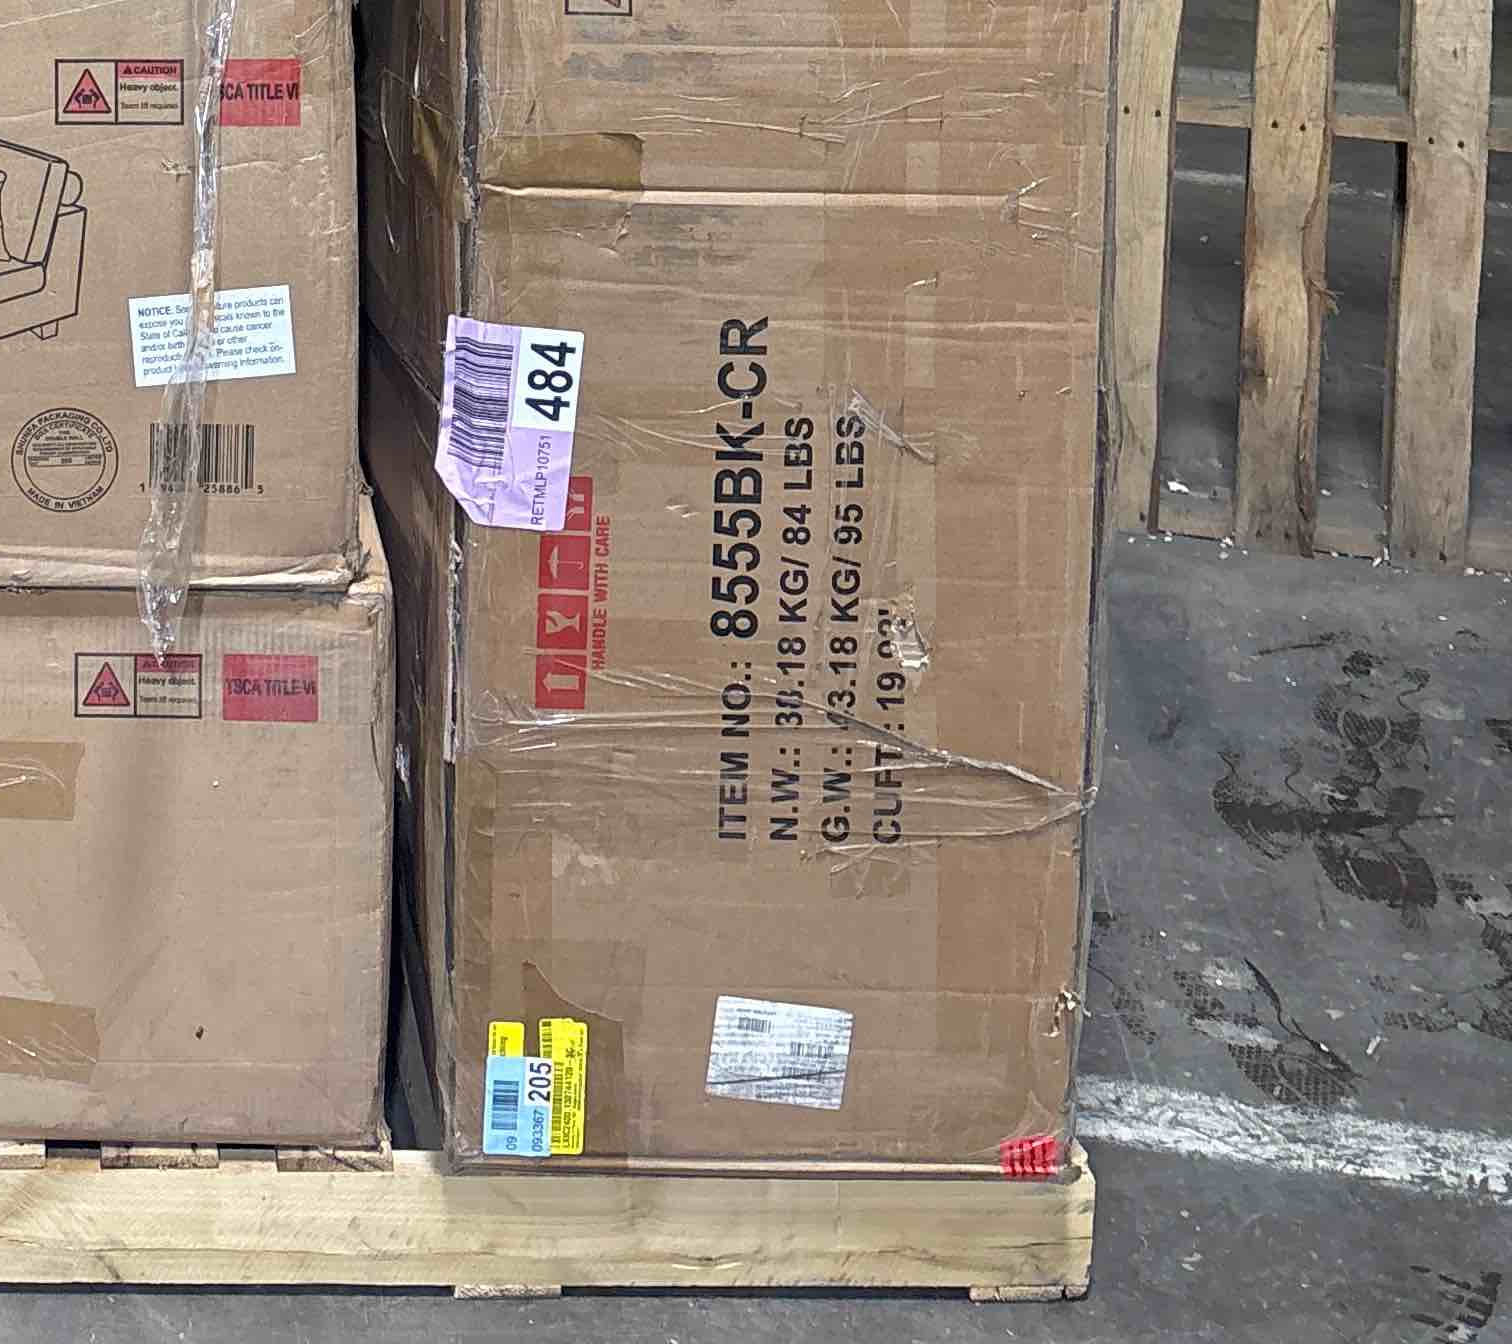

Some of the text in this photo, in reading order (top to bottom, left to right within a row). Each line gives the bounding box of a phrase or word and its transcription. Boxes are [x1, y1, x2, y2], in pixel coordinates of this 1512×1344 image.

[120, 83, 148, 94] Heavy
[134, 66, 178, 75] CAUTION
[246, 82, 300, 101] TITLE VI
[525, 340, 577, 423] 484
[15, 423, 39, 456] SHUNFA
[38, 411, 91, 427] PACKAGING
[834, 415, 867, 490] LBS
[26, 487, 51, 509] MADE
[530, 433, 550, 527] RETMLP10751
[834, 504, 865, 546] 95
[591, 515, 610, 673] HANDLE WITH CARE
[709, 314, 770, 841] ITEM NO.: 8555BK-CR
[828, 556, 863, 623] KG/
[768, 417, 816, 842] N.W.: 38.18 KG/ 84 LBS
[820, 745, 854, 844] G.W.:
[871, 717, 906, 846] CUFT:
[528, 1062, 552, 1103] 205
[505, 1135, 518, 1151] 09
[531, 1108, 545, 1153] 093367
